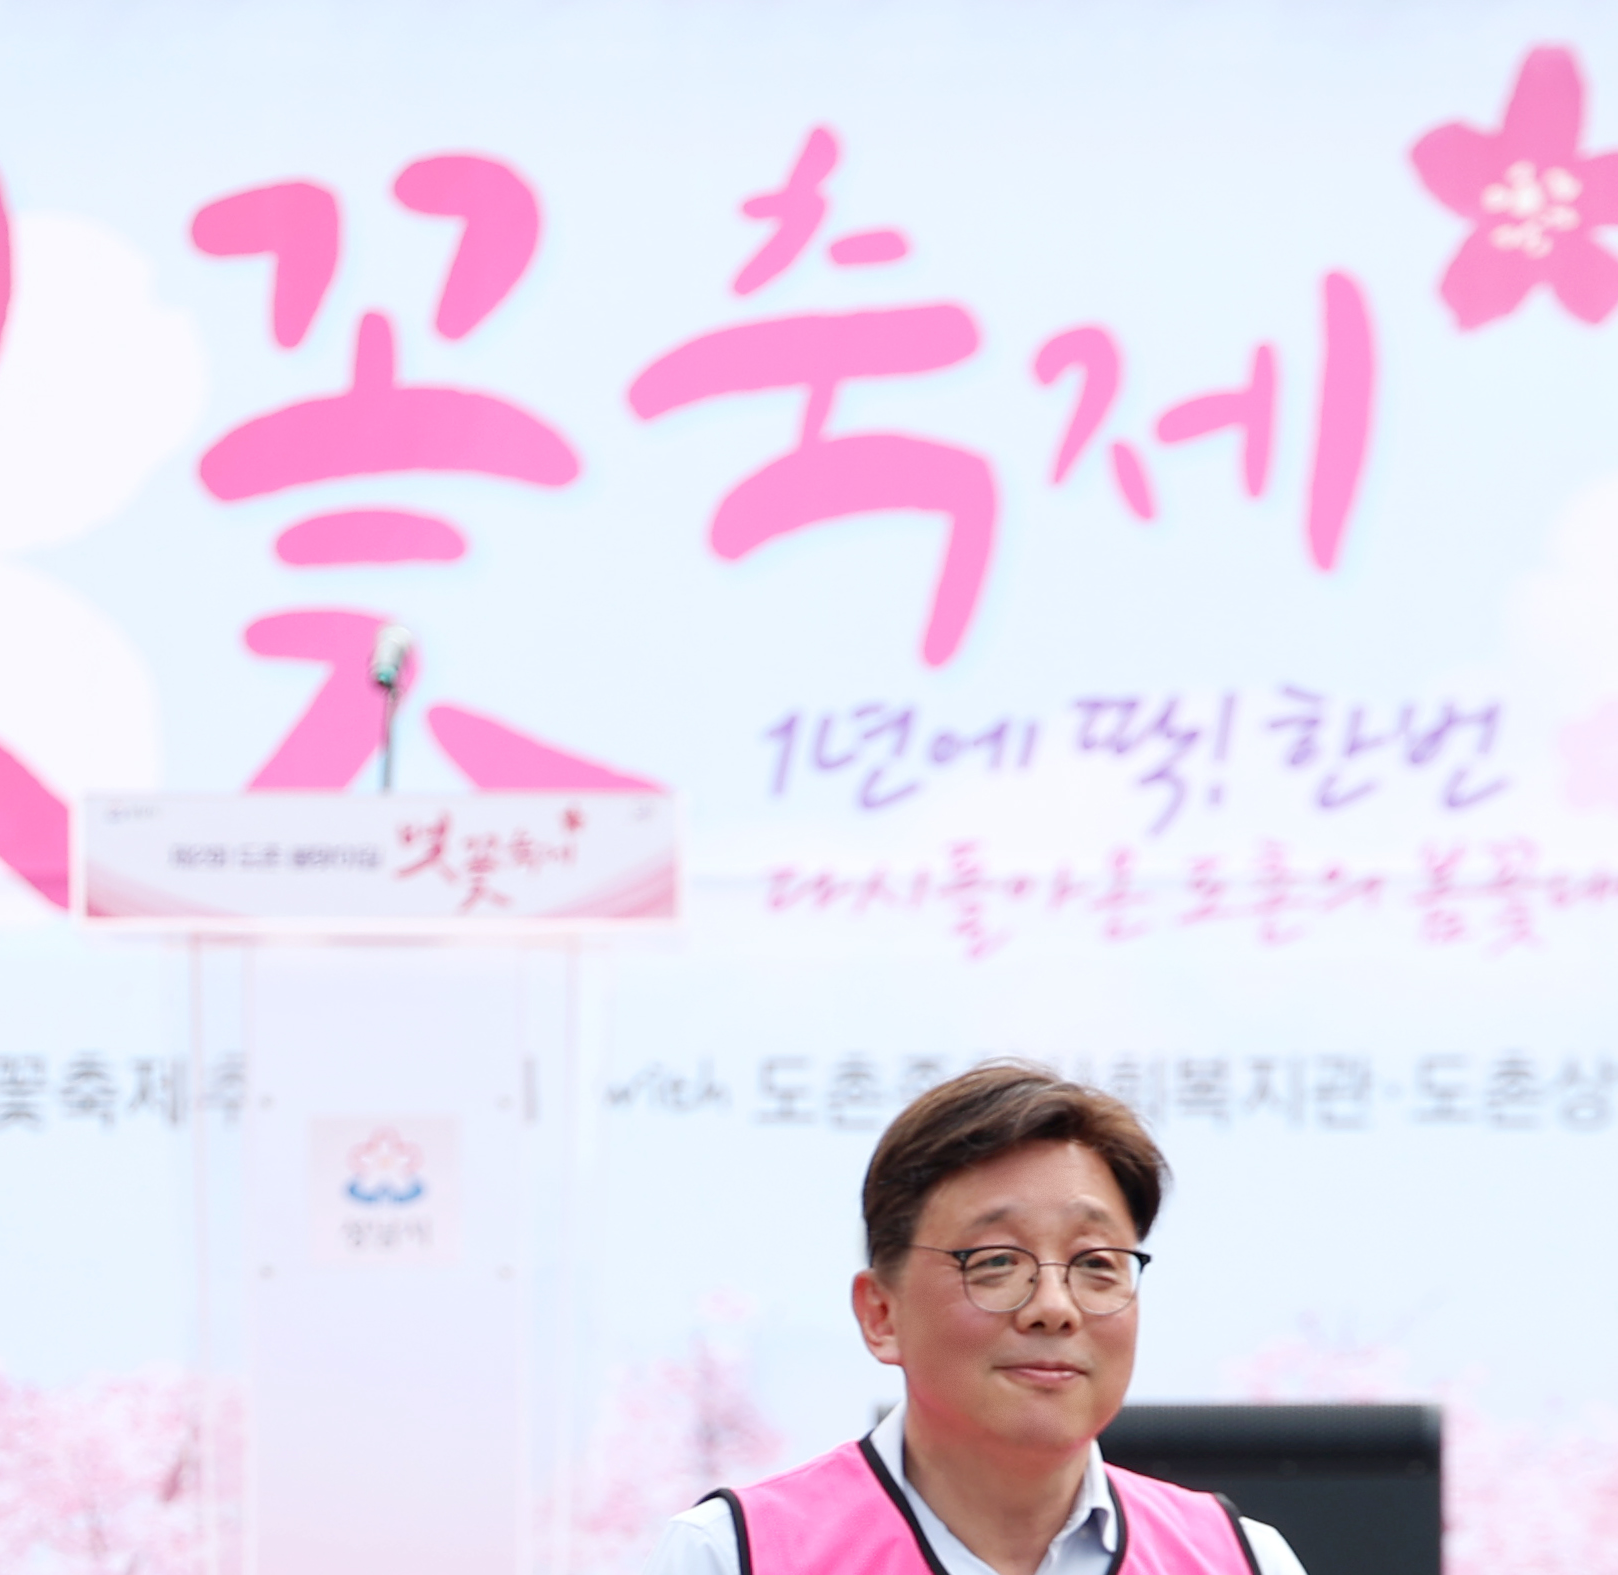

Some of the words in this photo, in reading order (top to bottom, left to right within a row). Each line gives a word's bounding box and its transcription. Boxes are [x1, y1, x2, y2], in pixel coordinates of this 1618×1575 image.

[765, 702, 1038, 813] 1년에
[1073, 689, 1238, 837] 딱!
[1268, 684, 1510, 812] 한번
